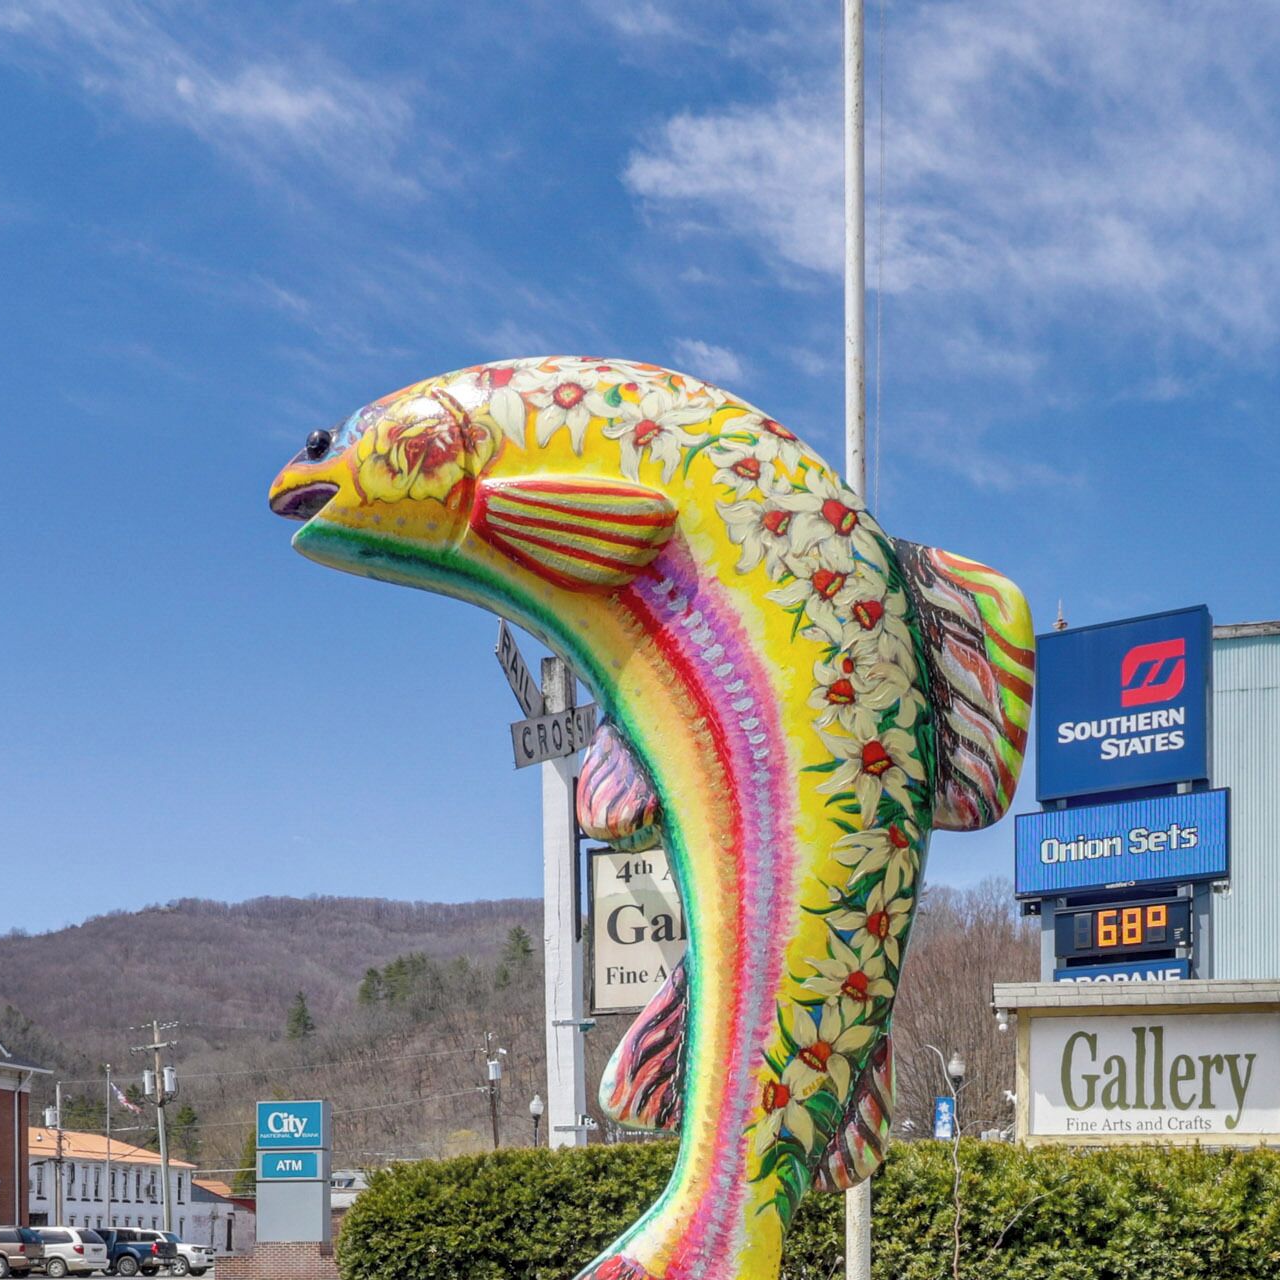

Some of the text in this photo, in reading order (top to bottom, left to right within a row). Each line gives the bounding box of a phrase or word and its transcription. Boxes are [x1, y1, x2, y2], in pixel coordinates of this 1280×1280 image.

[501, 628, 532, 713] RAIL
[1057, 706, 1186, 744] SOUTHERN
[1100, 730, 1186, 760] STATES
[1040, 823, 1199, 865] Onion Sets
[615, 860, 654, 884] 4th
[606, 965, 649, 986] Fine
[1060, 1025, 1257, 1130] Gallery
[267, 1111, 308, 1138] City
[1065, 1115, 1213, 1131] Fine Arts and Crafts
[276, 1159, 302, 1171] ATM
